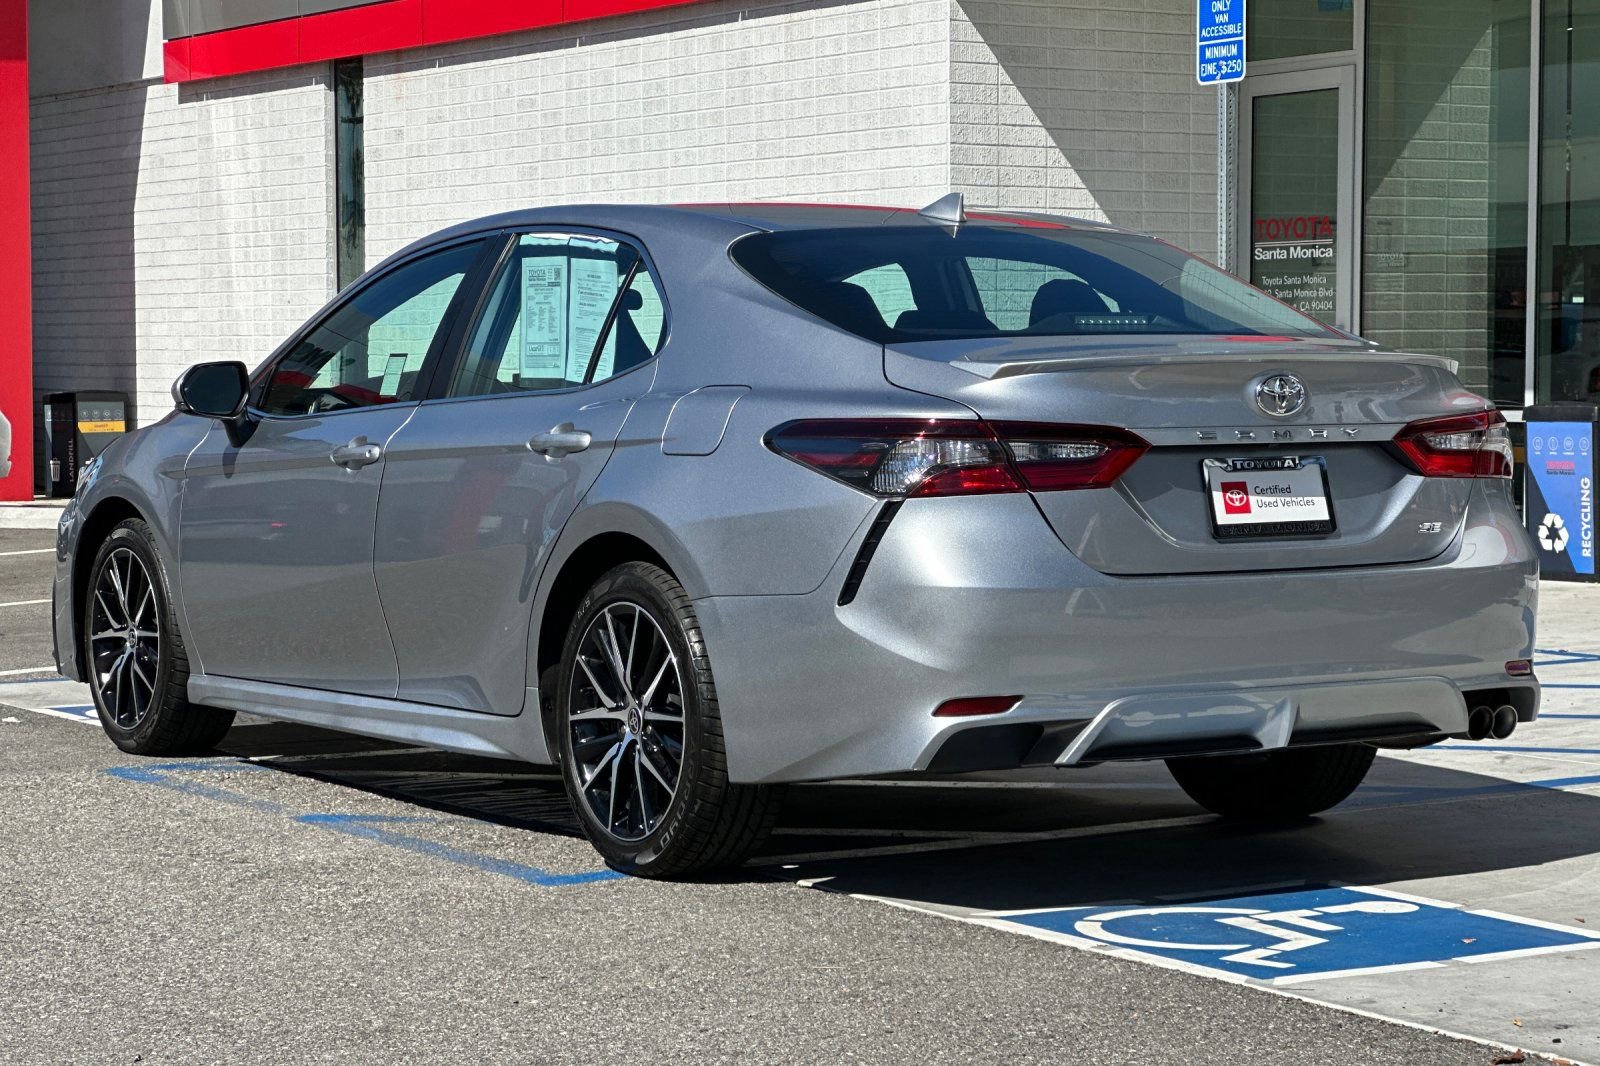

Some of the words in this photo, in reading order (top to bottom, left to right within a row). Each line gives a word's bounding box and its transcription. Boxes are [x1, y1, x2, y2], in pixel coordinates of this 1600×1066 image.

[1211, 0, 1231, 12] ONLY
[1215, 13, 1229, 23] VAN
[1201, 23, 1242, 38] ACCESSIBLE
[1205, 44, 1238, 60] MINIMUM
[1220, 59, 1242, 74] $250
[1255, 216, 1333, 240] TOYOTA
[1254, 248, 1287, 260] Santa
[1289, 245, 1333, 259] Monica
[1262, 276, 1282, 287] Toyota
[1283, 275, 1301, 285] Santa
[1303, 274, 1327, 284] Monica
[1275, 289, 1293, 298] Santa
[1294, 288, 1317, 297] Monica
[1318, 287, 1334, 297] Blvd
[1300, 301, 1310, 311] CA
[1311, 300, 1333, 310] 90404
[1233, 459, 1295, 469] TOYOTA
[1253, 484, 1292, 495] Certified
[1257, 499, 1279, 508] Used
[1279, 497, 1315, 508] Vehicles
[1581, 477, 1591, 557] RECYCLING
